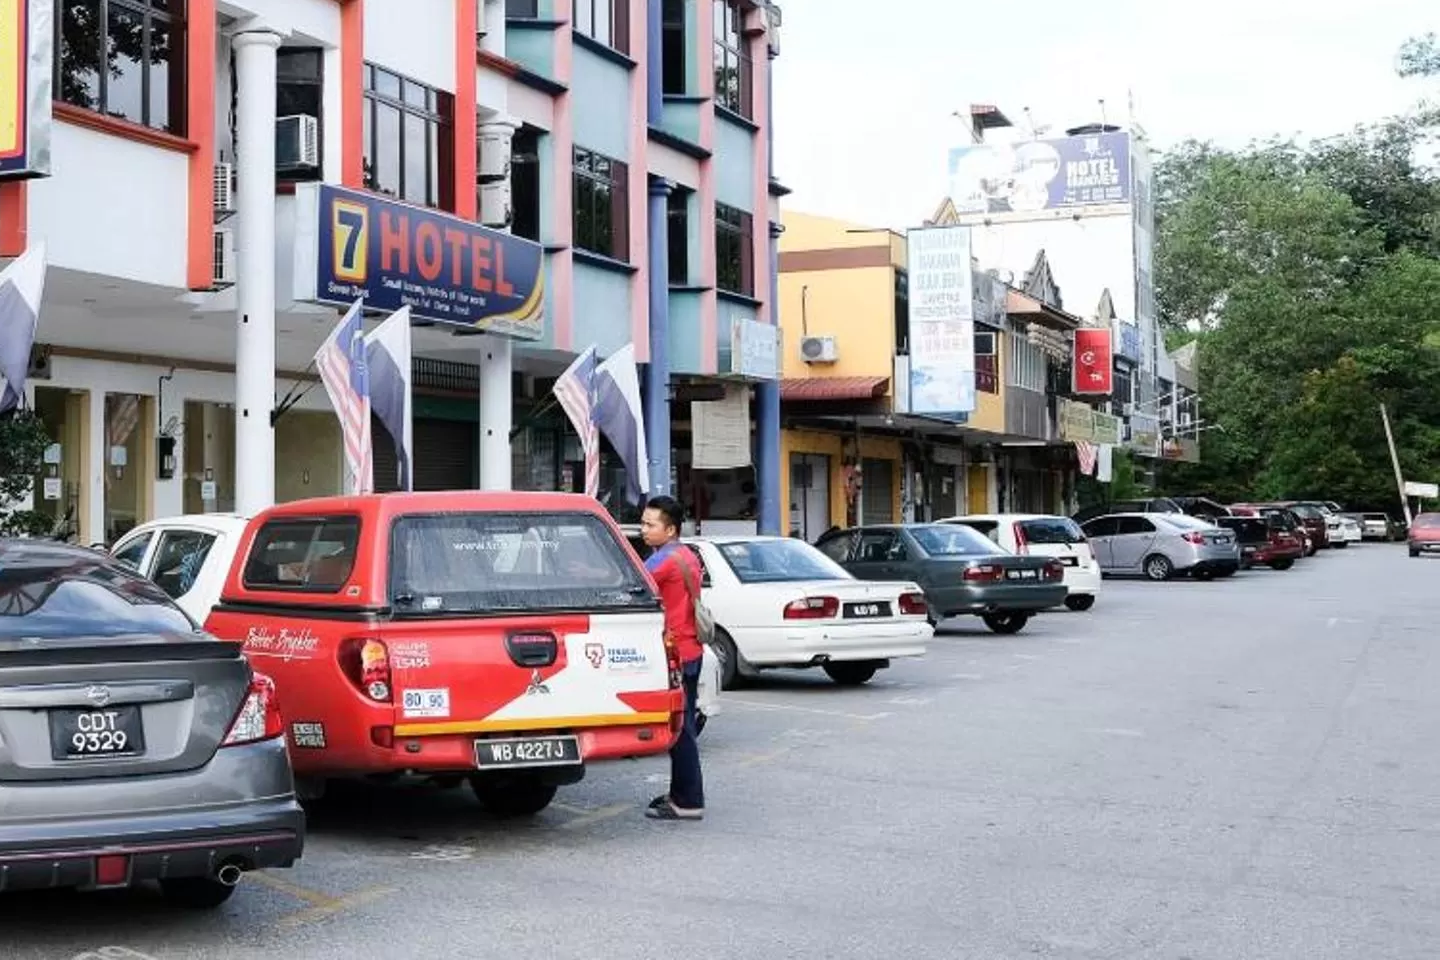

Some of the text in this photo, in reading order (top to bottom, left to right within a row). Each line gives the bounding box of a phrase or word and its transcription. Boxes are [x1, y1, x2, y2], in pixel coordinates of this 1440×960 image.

[338, 211, 513, 297] 7 HOTEL
[405, 692, 421, 707] 80
[78, 712, 118, 733] CDT
[72, 732, 127, 753] 9329
[491, 741, 564, 761] WB 4227J
